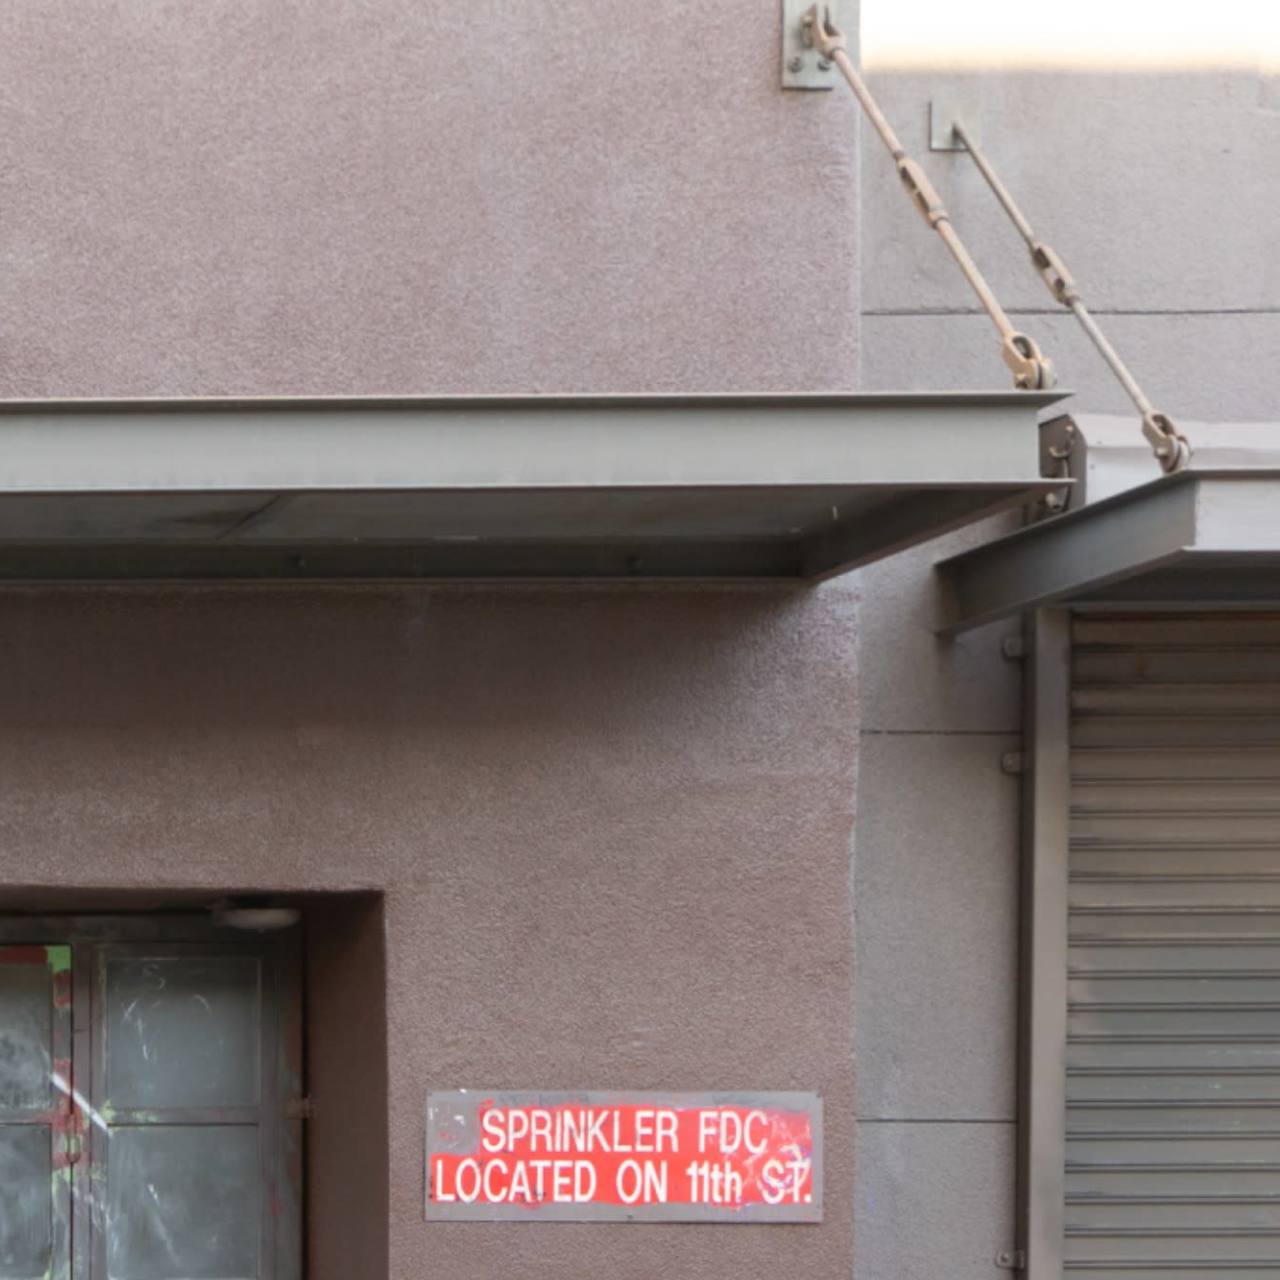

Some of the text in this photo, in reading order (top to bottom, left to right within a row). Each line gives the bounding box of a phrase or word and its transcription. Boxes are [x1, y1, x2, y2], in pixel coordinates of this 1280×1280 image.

[481, 1109, 770, 1153] SPRINKLER FDC
[436, 1159, 597, 1203] LOCATED
[616, 1160, 668, 1203] ON
[687, 1164, 742, 1203] 11th
